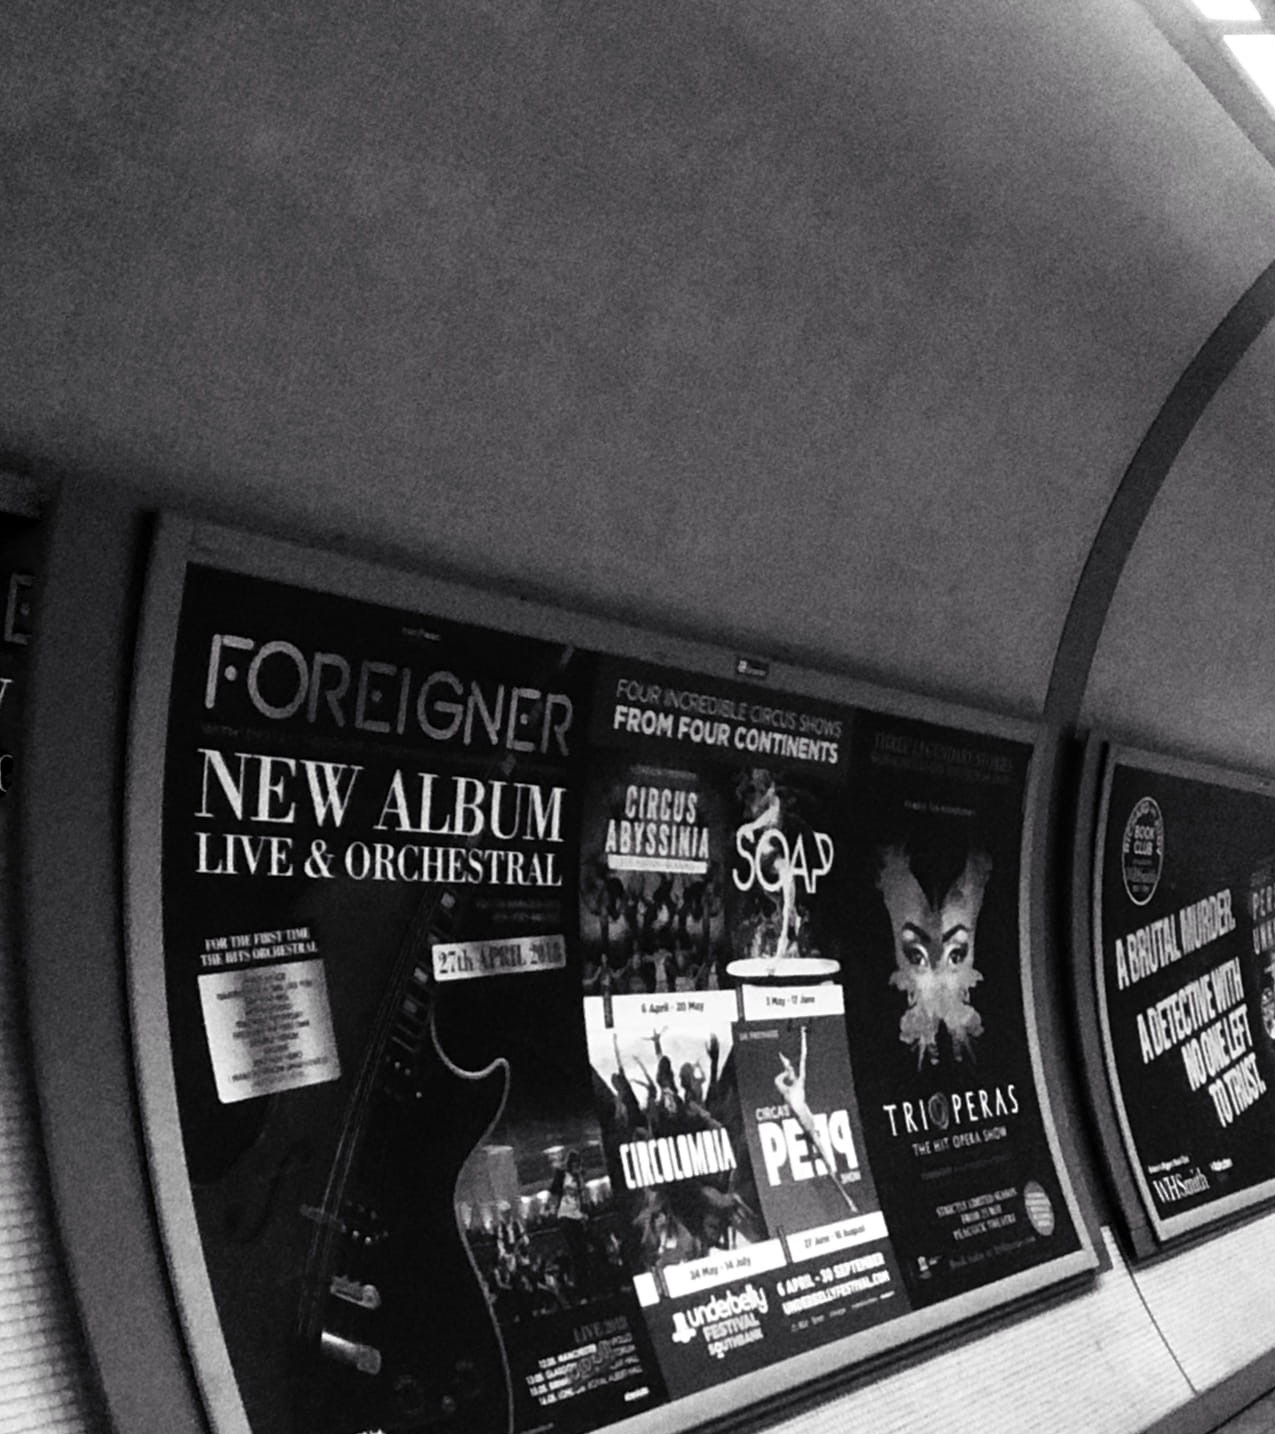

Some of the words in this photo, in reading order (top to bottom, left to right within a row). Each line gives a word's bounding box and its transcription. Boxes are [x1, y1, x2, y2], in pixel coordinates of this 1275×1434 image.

[204, 633, 573, 757] FOREIGNER
[616, 678, 661, 704] FOUR
[664, 689, 747, 721] INCREDIBLE
[749, 705, 797, 730] CIRCUS
[799, 714, 842, 738] SHOWS
[613, 705, 674, 739] FROM
[678, 716, 731, 747] FOUR
[733, 726, 839, 764] CONTINENTS
[194, 748, 364, 828] NEW
[373, 769, 567, 842] ALBUM
[624, 784, 698, 824] CIRCUS
[605, 819, 709, 858] ABYSSINIA
[1133, 825, 1155, 840] BOOK
[1133, 841, 1154, 856] CLUB
[195, 832, 294, 876] LIVE
[304, 838, 336, 878] &
[344, 841, 563, 887] ORCHESTRAL
[732, 822, 834, 894] SOAP
[200, 953, 224, 967] THE
[252, 940, 318, 960] ORCHESTRAL
[205, 937, 228, 952] FOR
[230, 934, 253, 949] THE
[254, 930, 283, 945] FIRST
[286, 927, 311, 941] TIME
[440, 948, 474, 973] 27th
[481, 943, 526, 970] APRIL
[1115, 939, 1130, 990] A
[1126, 913, 1182, 984] BRUTAL
[1179, 888, 1236, 956] MURDER.
[1136, 1013, 1155, 1064] A
[1146, 973, 1216, 1057] DETECTIVE
[1210, 956, 1245, 1014] WITH
[1181, 1038, 1207, 1092] NO
[1200, 1020, 1231, 1078] ONE
[1222, 1003, 1253, 1060] LEFT
[882, 1084, 1020, 1137] TRIOPERAS
[1207, 1079, 1234, 1128] TO
[1222, 1052, 1267, 1116] TRUST.
[619, 1127, 737, 1189] CIRCOLOMBIA
[912, 1140, 932, 1157] THE
[933, 1137, 951, 1153] HIT
[952, 1130, 983, 1149] OPERA
[982, 1125, 1008, 1142] SHOW
[1152, 1167, 1210, 1203] WHSmith
[686, 1284, 769, 1327] underbelly
[702, 1312, 760, 1342] FESTIVAL
[708, 1328, 764, 1359] SOUTHBANK
